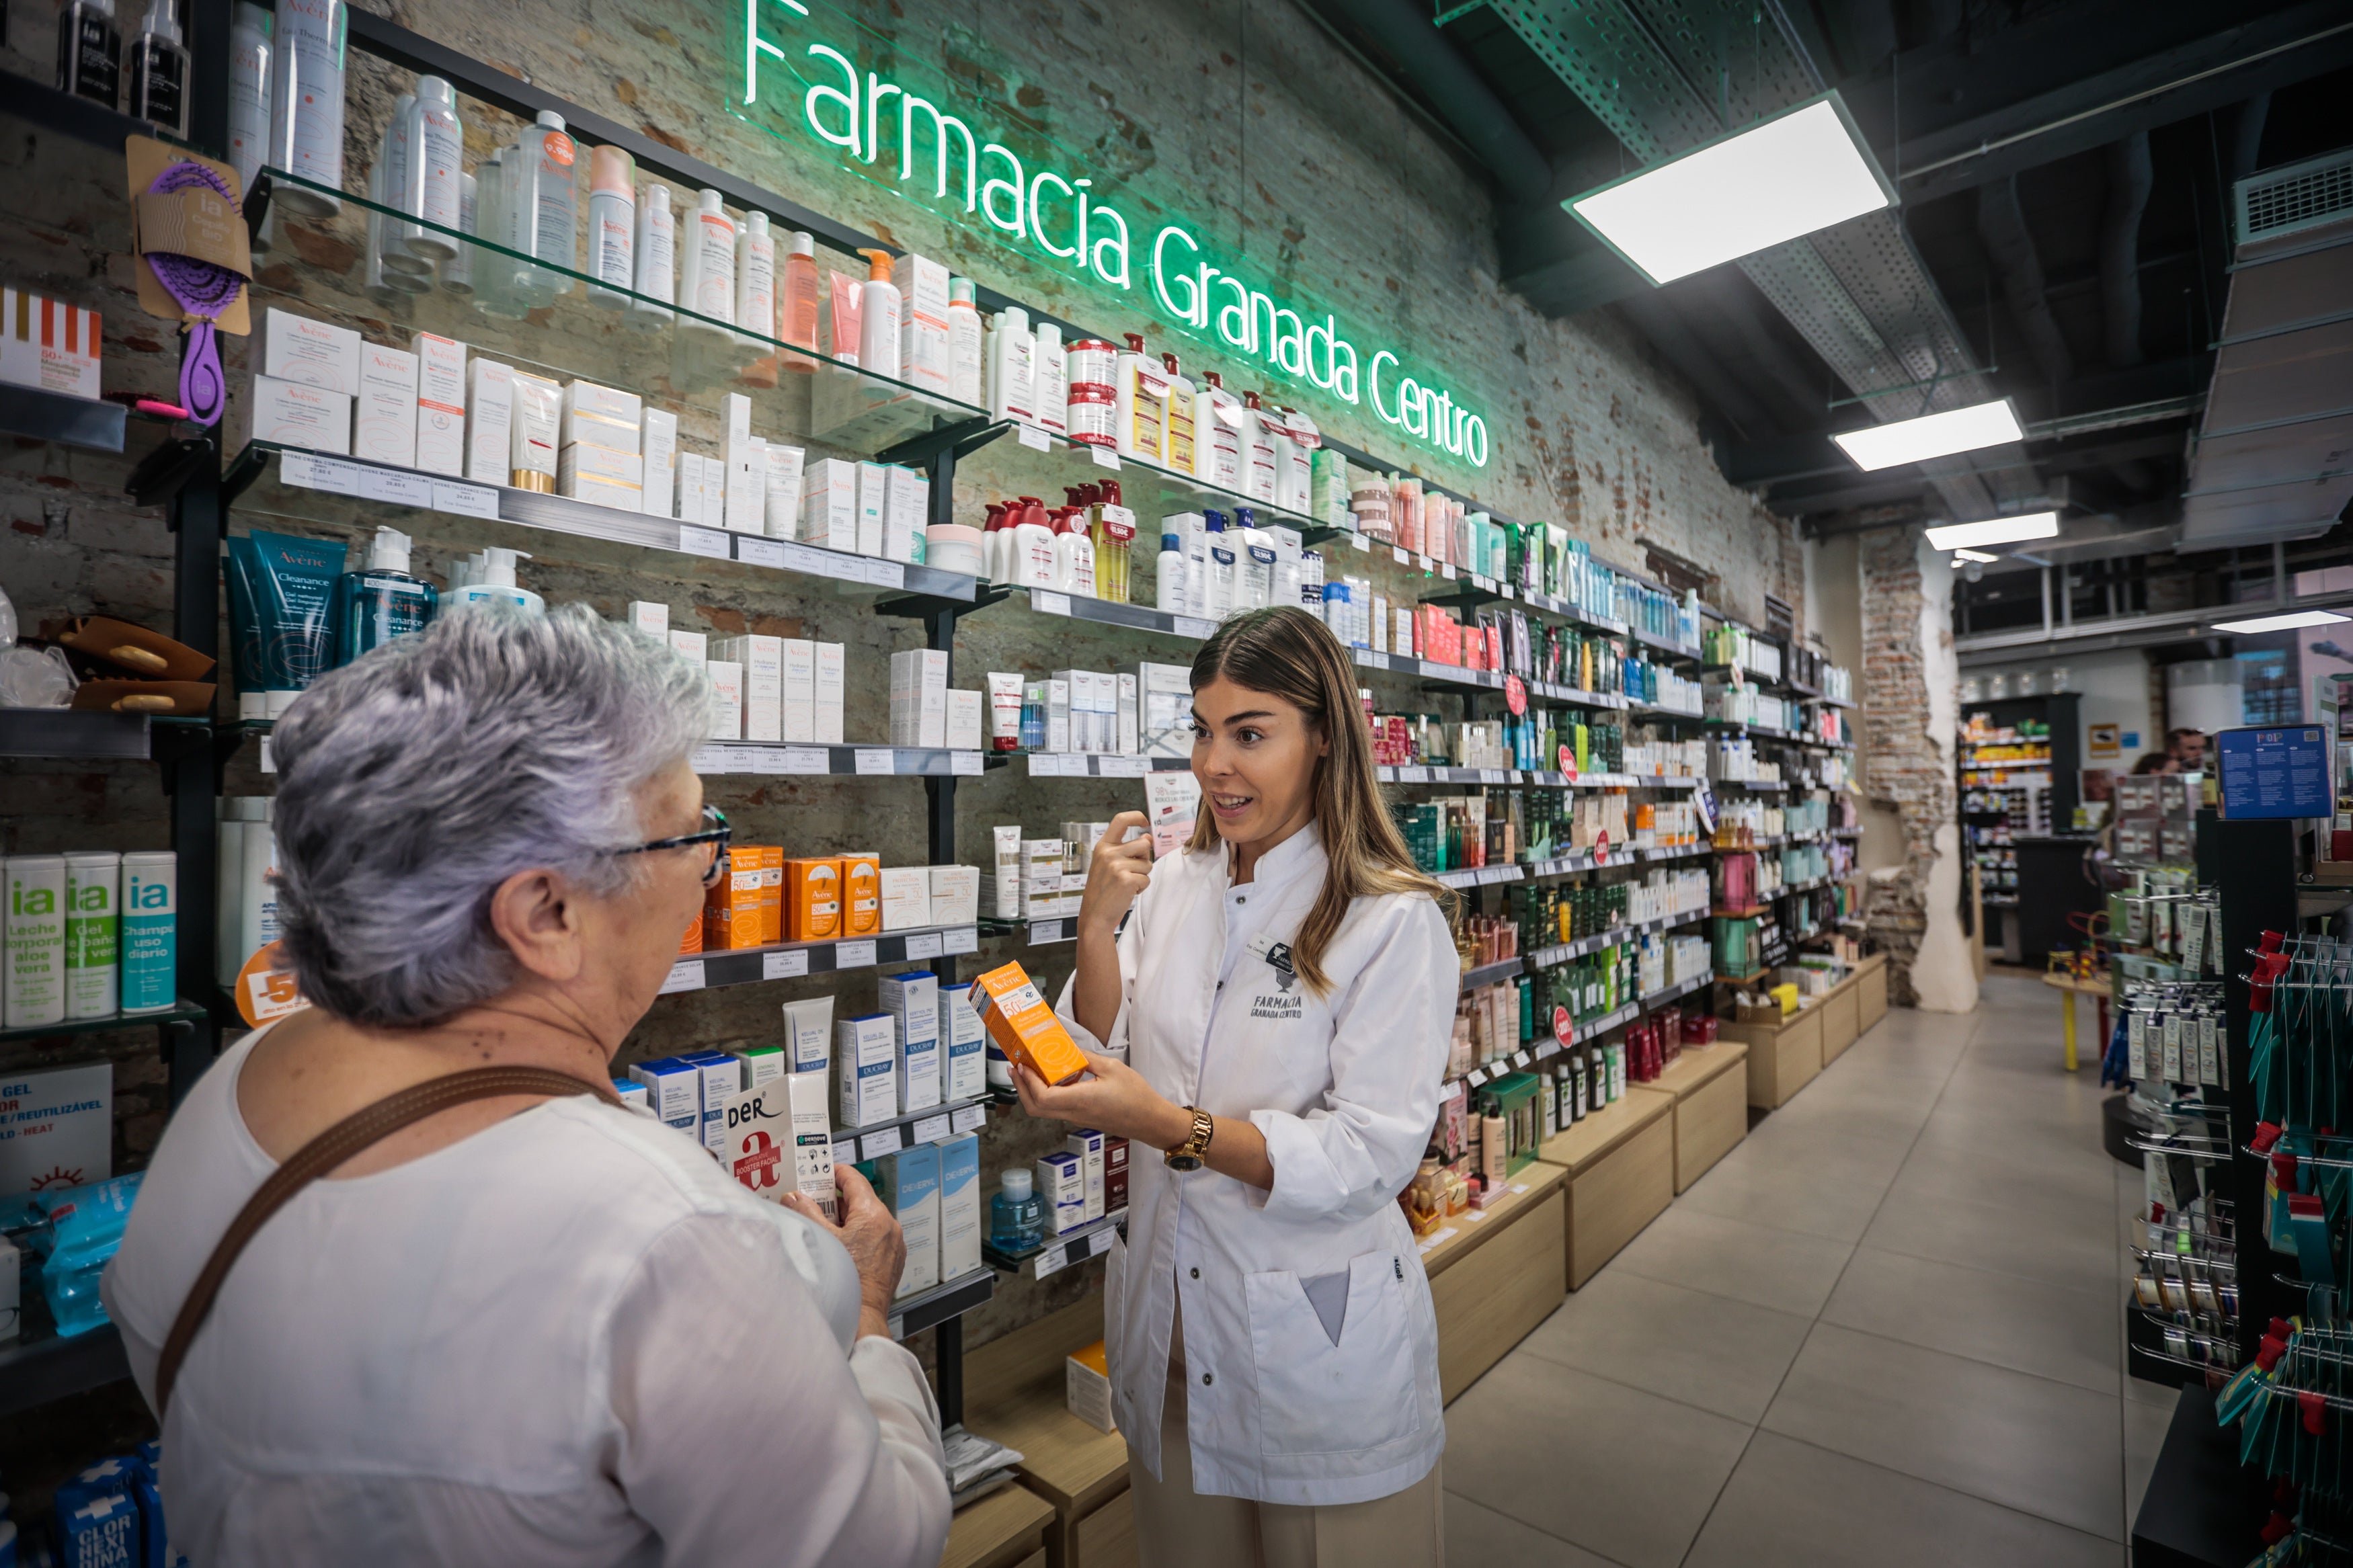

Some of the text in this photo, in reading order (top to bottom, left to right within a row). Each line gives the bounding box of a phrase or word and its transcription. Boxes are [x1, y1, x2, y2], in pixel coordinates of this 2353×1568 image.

[201, 193, 223, 217] ia
[299, 323, 332, 339] Avène
[1149, 226, 1359, 405] Granada
[1370, 350, 1488, 468] Centro
[372, 356, 408, 372] Avène
[288, 388, 321, 403] Avène
[280, 551, 327, 567] Avène
[278, 573, 329, 586] Cleanance
[376, 597, 422, 614] Avène
[373, 613, 423, 626] Cleanance
[715, 682, 737, 692] Avène
[735, 860, 758, 868] Avène
[12, 880, 55, 915] ia
[68, 877, 108, 911] ia
[130, 876, 168, 909] ia
[812, 890, 832, 898] Avène
[855, 887, 872, 895] Avène
[9, 923, 56, 936] Leche
[76, 924, 102, 936] Gel
[134, 937, 162, 947] uso
[15, 950, 50, 962] aloe
[128, 948, 168, 959] diario
[15, 962, 50, 974] vera
[992, 975, 1023, 991] Avène
[1250, 1008, 1302, 1019] GRANADA CENTRO
[910, 1042, 933, 1052] DUCRAY
[955, 1042, 980, 1053] DUCRAY
[803, 1061, 825, 1069] DUCRAY
[863, 1063, 889, 1075] DUCRAY
[3, 1083, 32, 1098] GEL
[17, 1100, 103, 1122] REUTILIZÁVEL
[24, 1124, 54, 1137] HEAT
[744, 1151, 768, 1164] SUPERLATIVE
[736, 1155, 779, 1175] BOOSTER FACIAL
[79, 1514, 131, 1544] CLOR
[79, 1532, 125, 1561] HEXI
